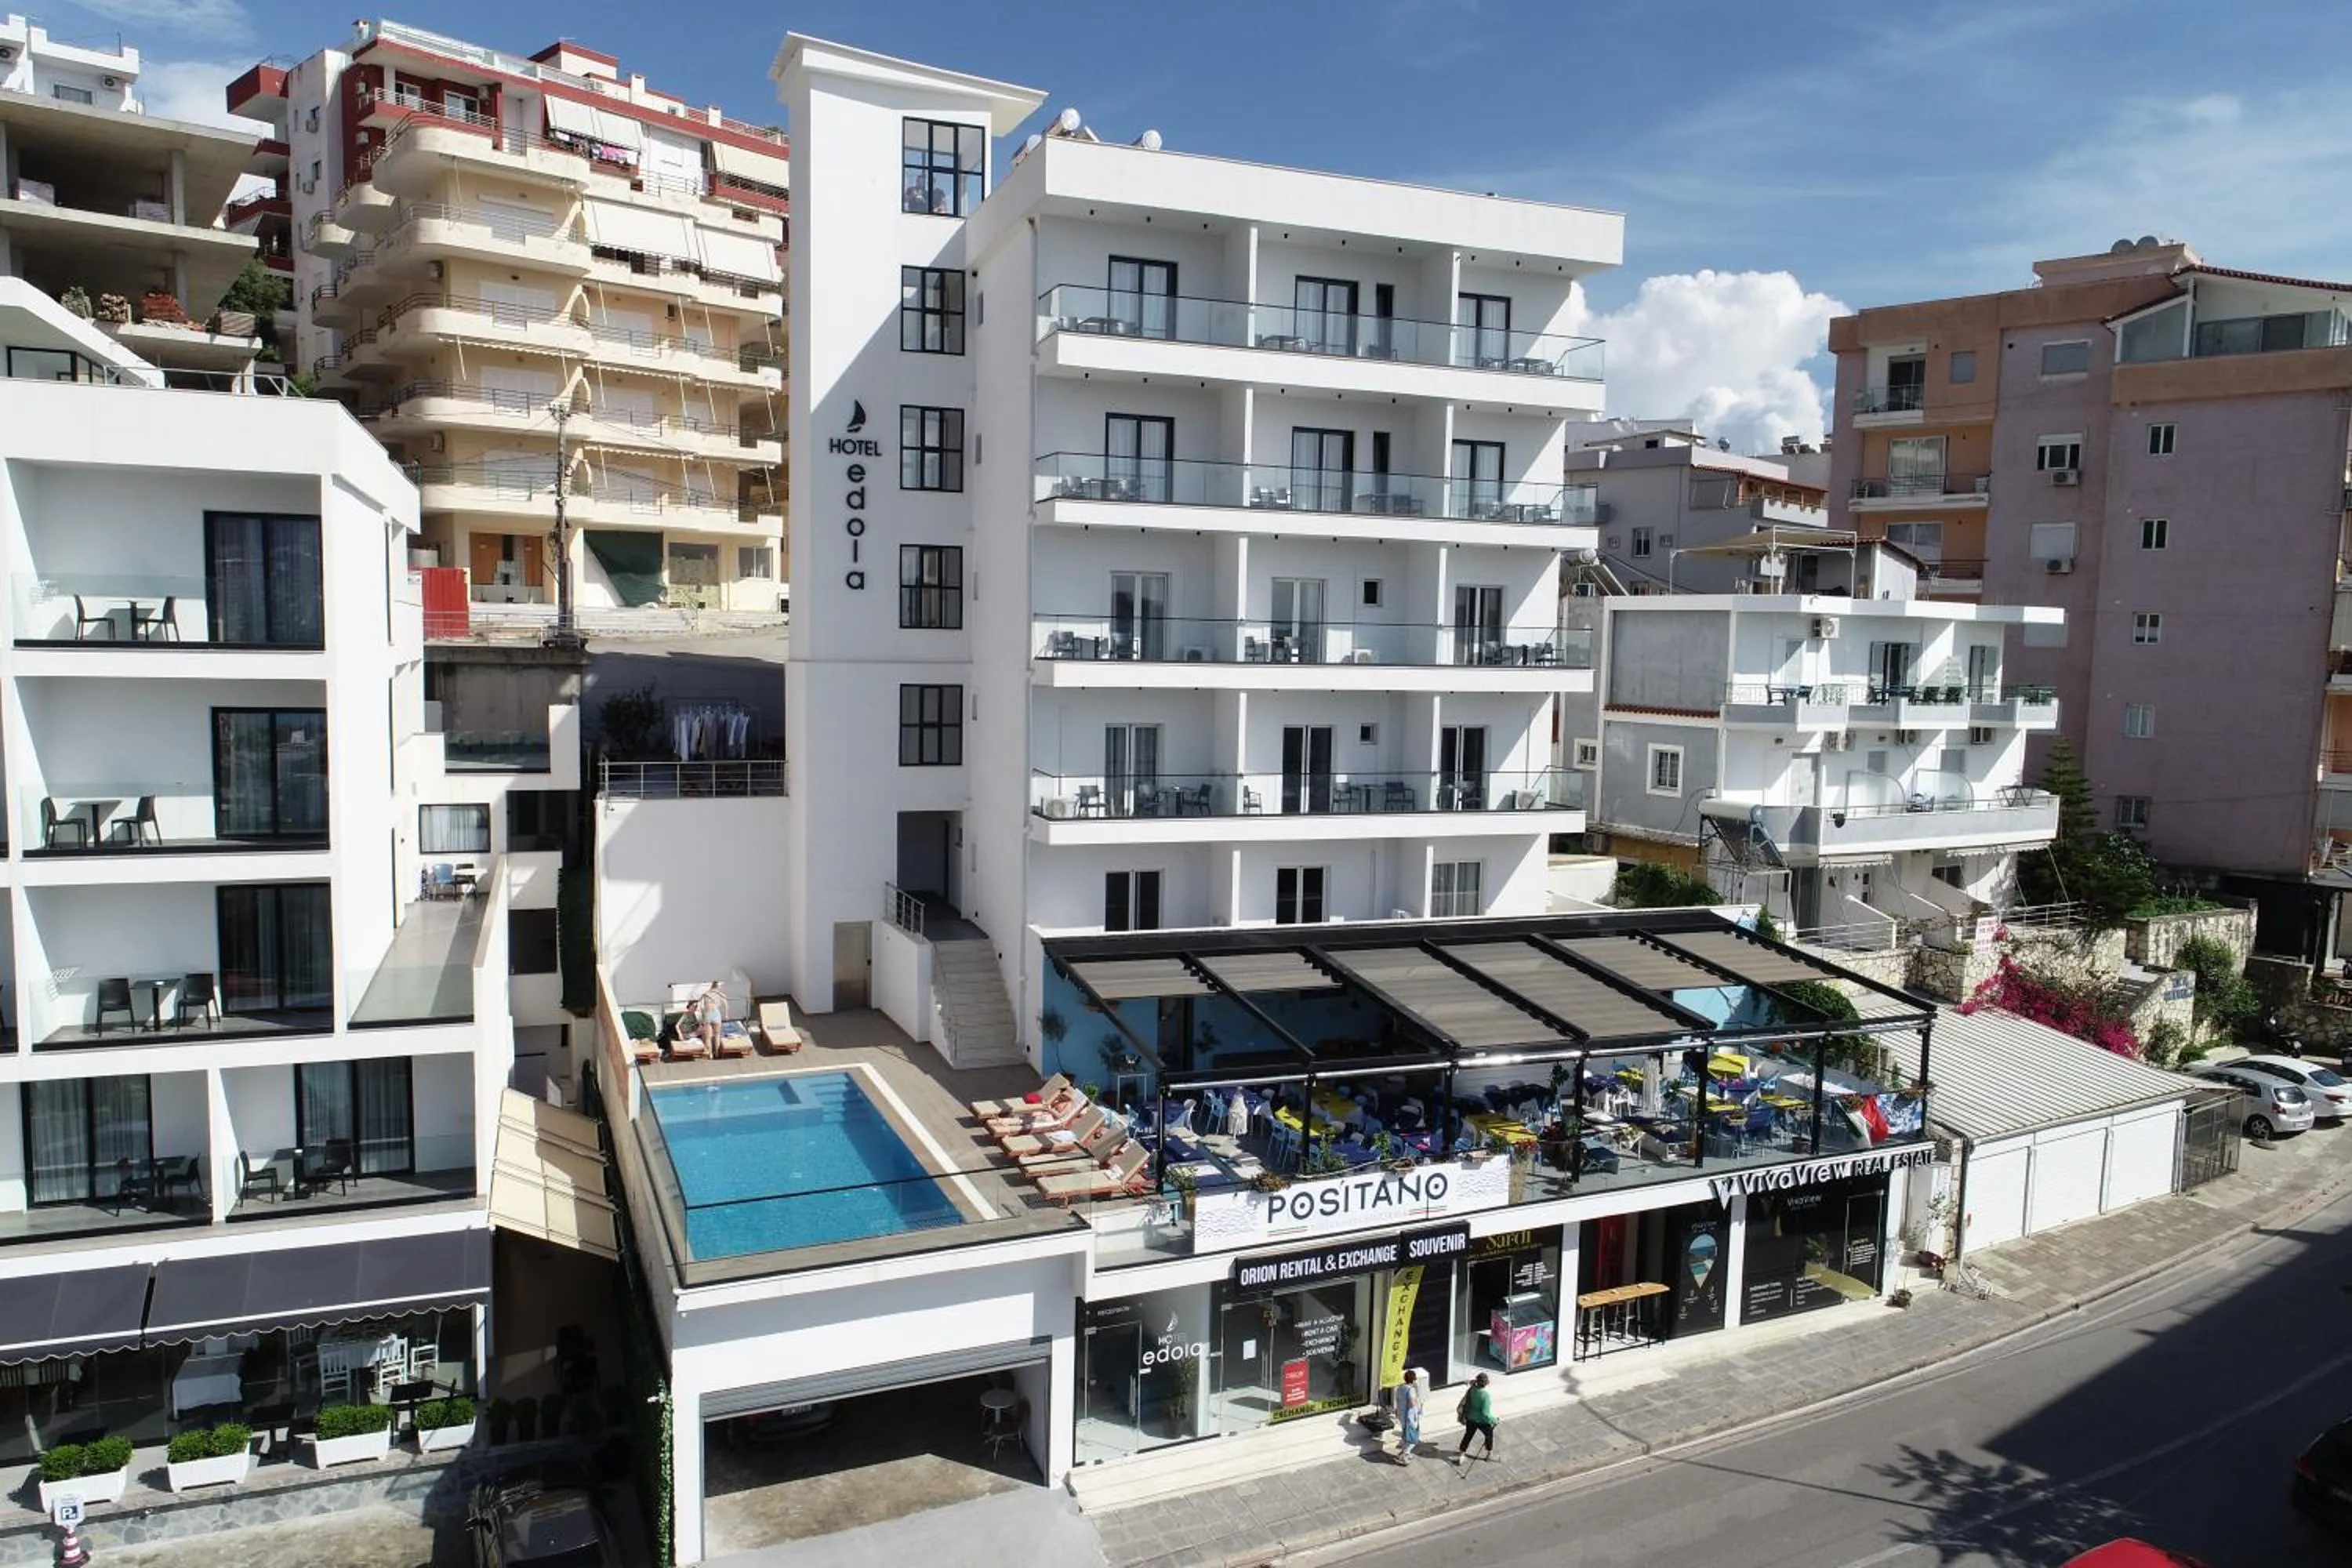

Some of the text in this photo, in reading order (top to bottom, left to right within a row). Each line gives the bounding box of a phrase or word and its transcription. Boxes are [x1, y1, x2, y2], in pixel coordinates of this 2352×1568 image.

[829, 438, 882, 456] HOTEL
[846, 464, 866, 590] edola
[1855, 1154, 1888, 1177] REAL
[1892, 1149, 1936, 1171] ESTATE
[1409, 1232, 1466, 1258] SOUVENIR
[1240, 1244, 1398, 1286] ORION RENTAL & EXCHANGE
[1392, 1270, 1414, 1364] EXCHANGE
